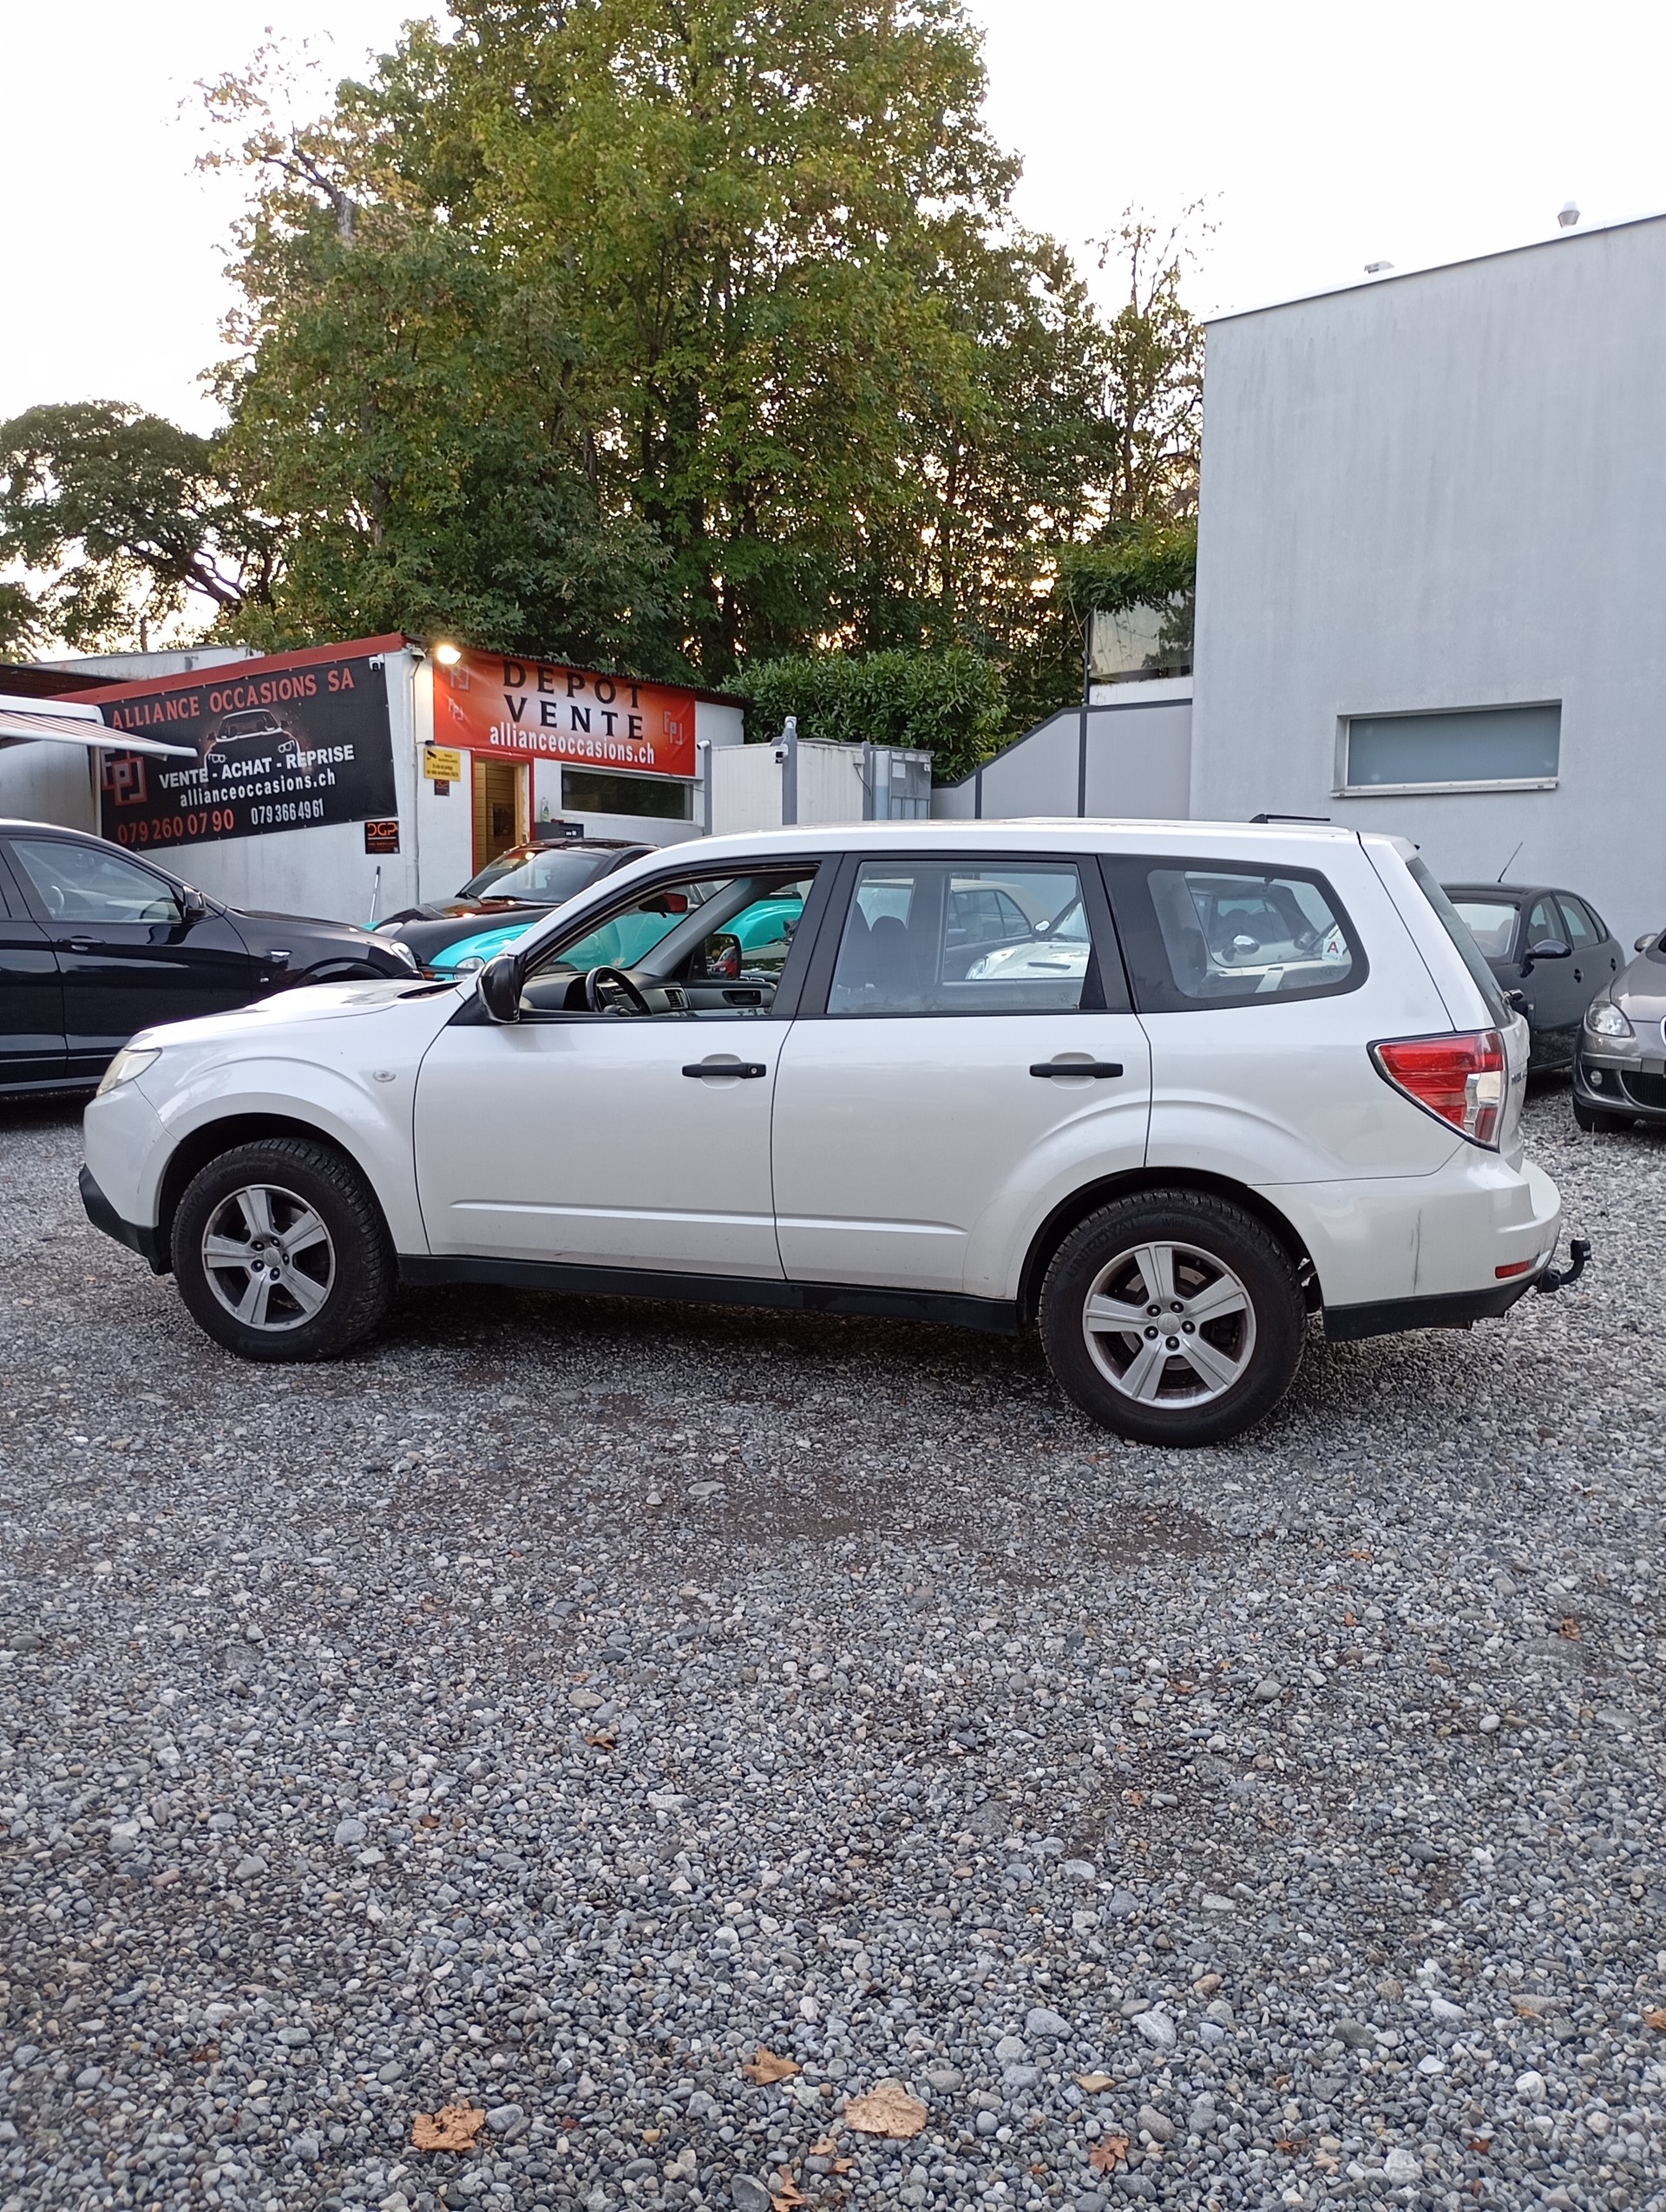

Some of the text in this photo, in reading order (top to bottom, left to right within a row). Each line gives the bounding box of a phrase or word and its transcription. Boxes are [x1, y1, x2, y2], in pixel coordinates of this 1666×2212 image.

[113, 667, 355, 729] ALLIANCE OCCASIONS SA
[502, 659, 643, 709] DEPOT
[503, 694, 643, 740] VENTE
[490, 722, 655, 764] allianceoccasions.ch
[159, 768, 209, 789] VENTE
[221, 757, 272, 780] ACHAT
[286, 744, 355, 769] REPRISE
[180, 768, 336, 808] allianceoccasions.ch
[118, 821, 148, 844] 079
[153, 816, 183, 840] 260
[213, 808, 234, 832] 90
[1327, 941, 1339, 953] A
